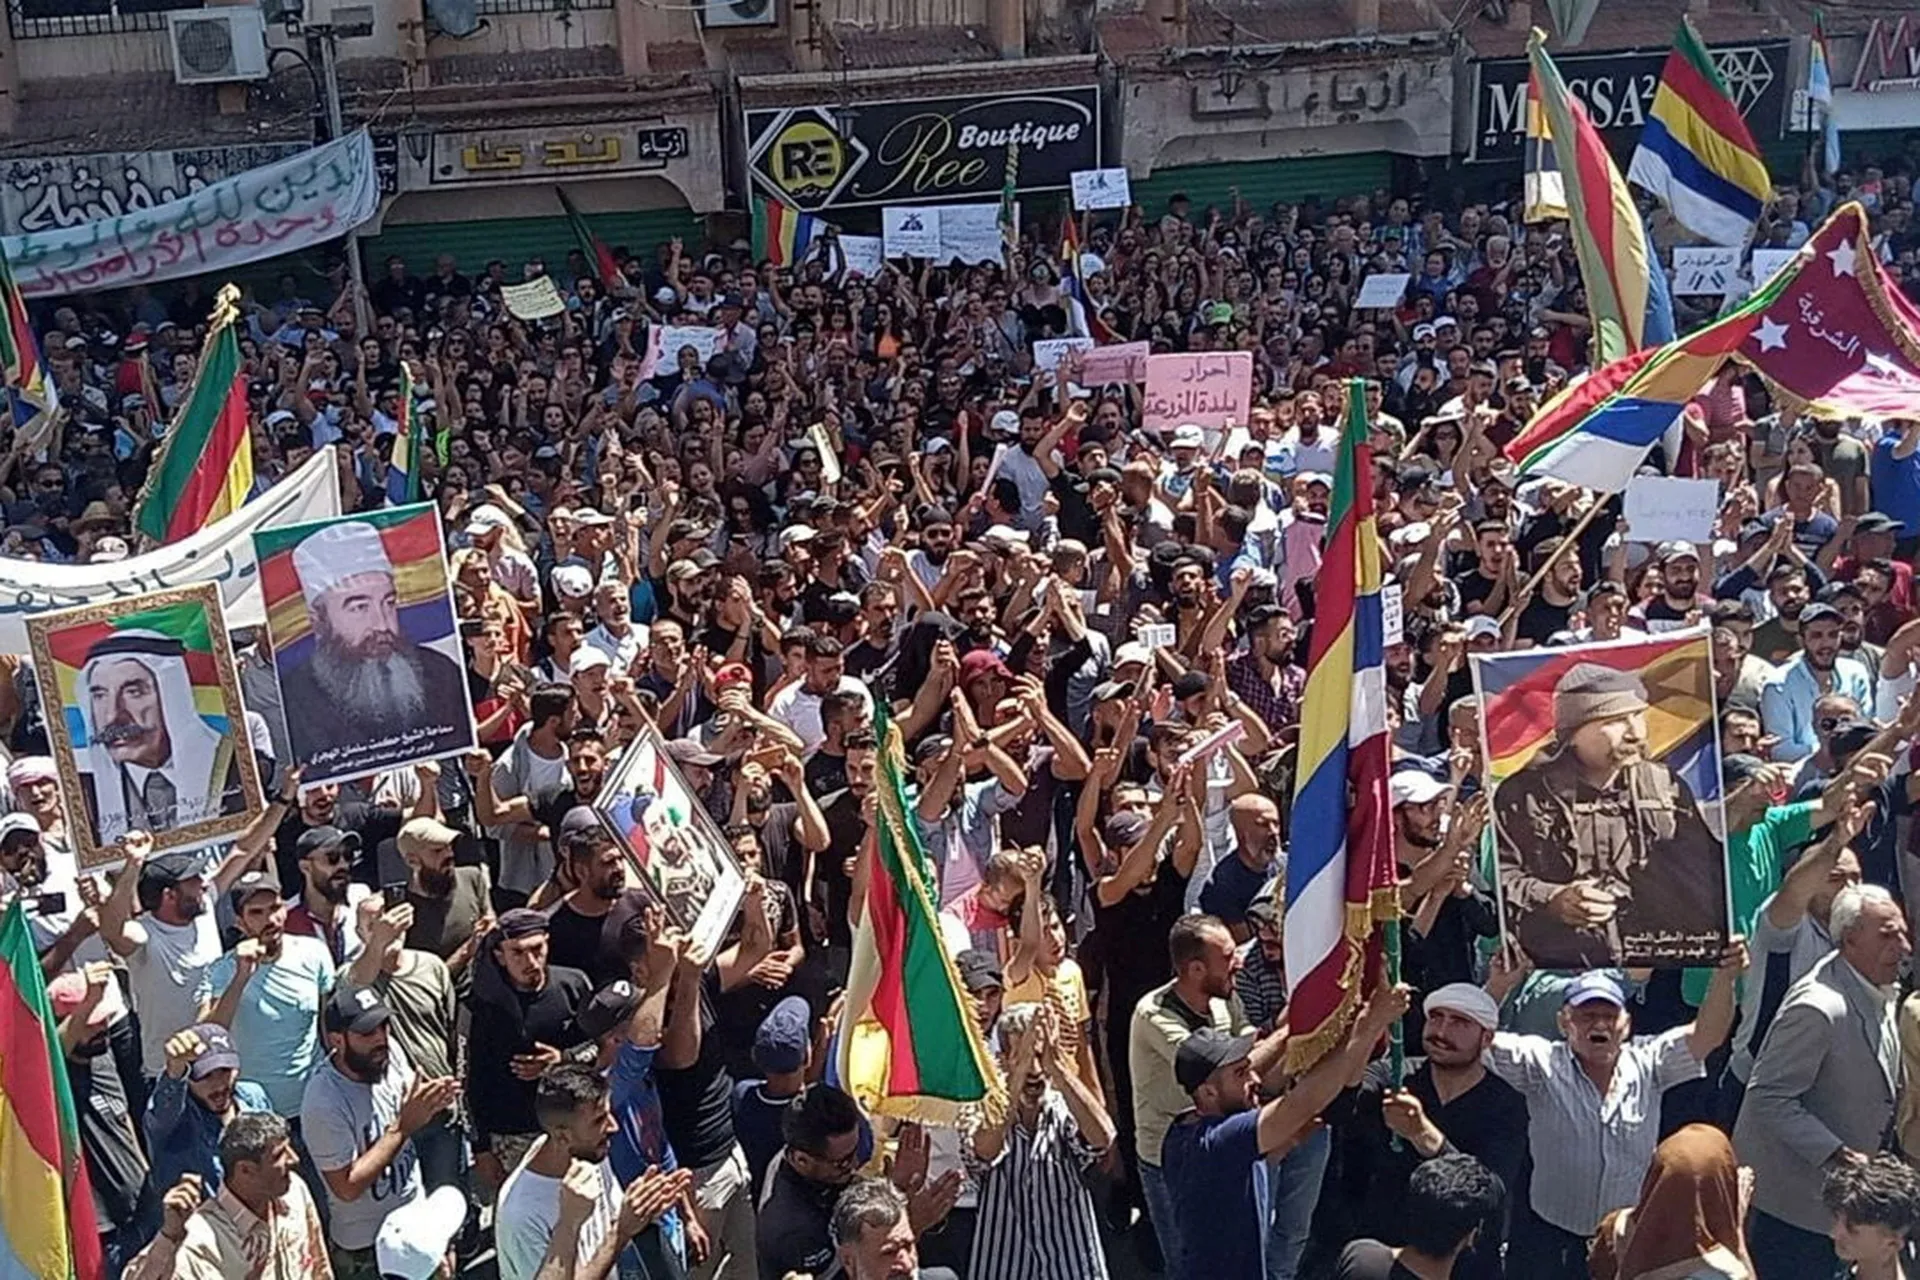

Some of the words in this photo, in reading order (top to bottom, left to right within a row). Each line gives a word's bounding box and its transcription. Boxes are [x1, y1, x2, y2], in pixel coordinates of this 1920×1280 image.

[851, 111, 990, 198] Ree
[957, 122, 1080, 149] Boutique
[1797, 292, 1862, 359] الشرقية
[1198, 390, 1238, 418] بلدة
